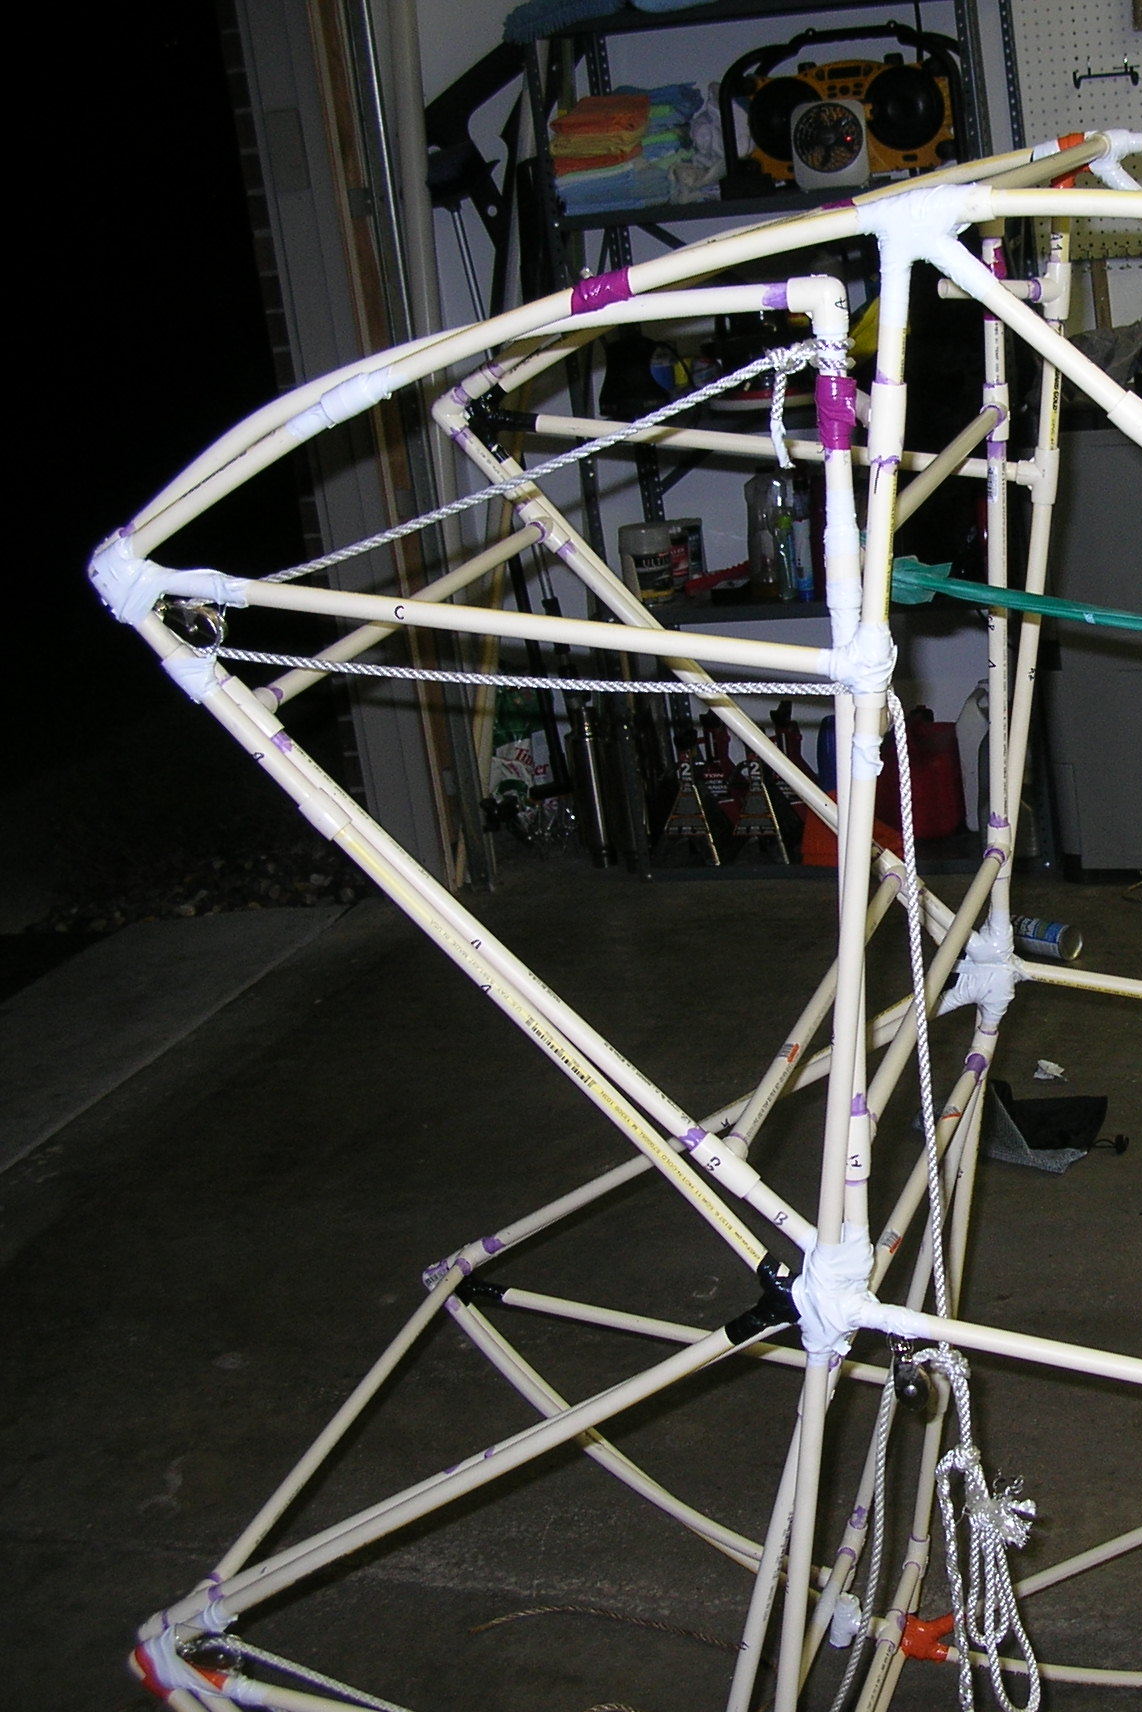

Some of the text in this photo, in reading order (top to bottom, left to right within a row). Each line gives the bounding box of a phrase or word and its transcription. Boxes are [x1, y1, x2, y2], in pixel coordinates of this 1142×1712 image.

[394, 606, 405, 620] C
[681, 762, 691, 776] 2
[750, 761, 760, 775] 2
